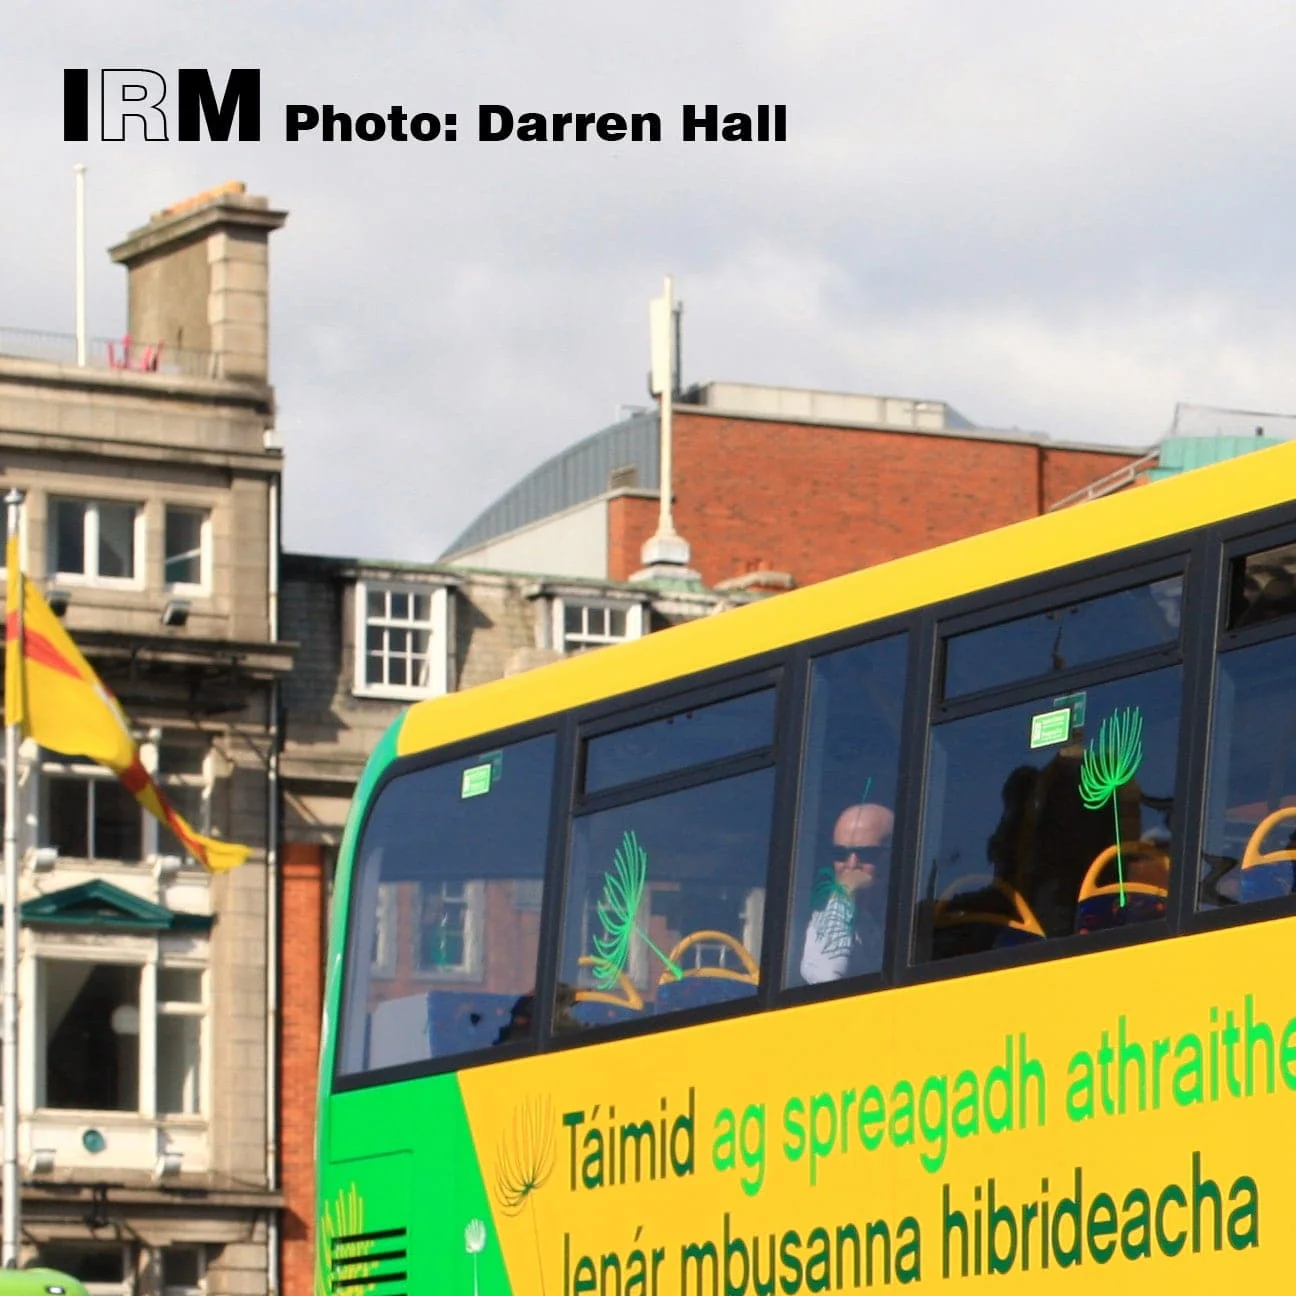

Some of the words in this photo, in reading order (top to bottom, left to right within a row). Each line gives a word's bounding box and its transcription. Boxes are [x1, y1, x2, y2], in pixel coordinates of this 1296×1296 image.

[562, 1086, 695, 1192] Táimid
[711, 1103, 766, 1197] ag
[782, 1032, 1046, 1187] spreagadh
[943, 1150, 1259, 1279] hibrideacha
